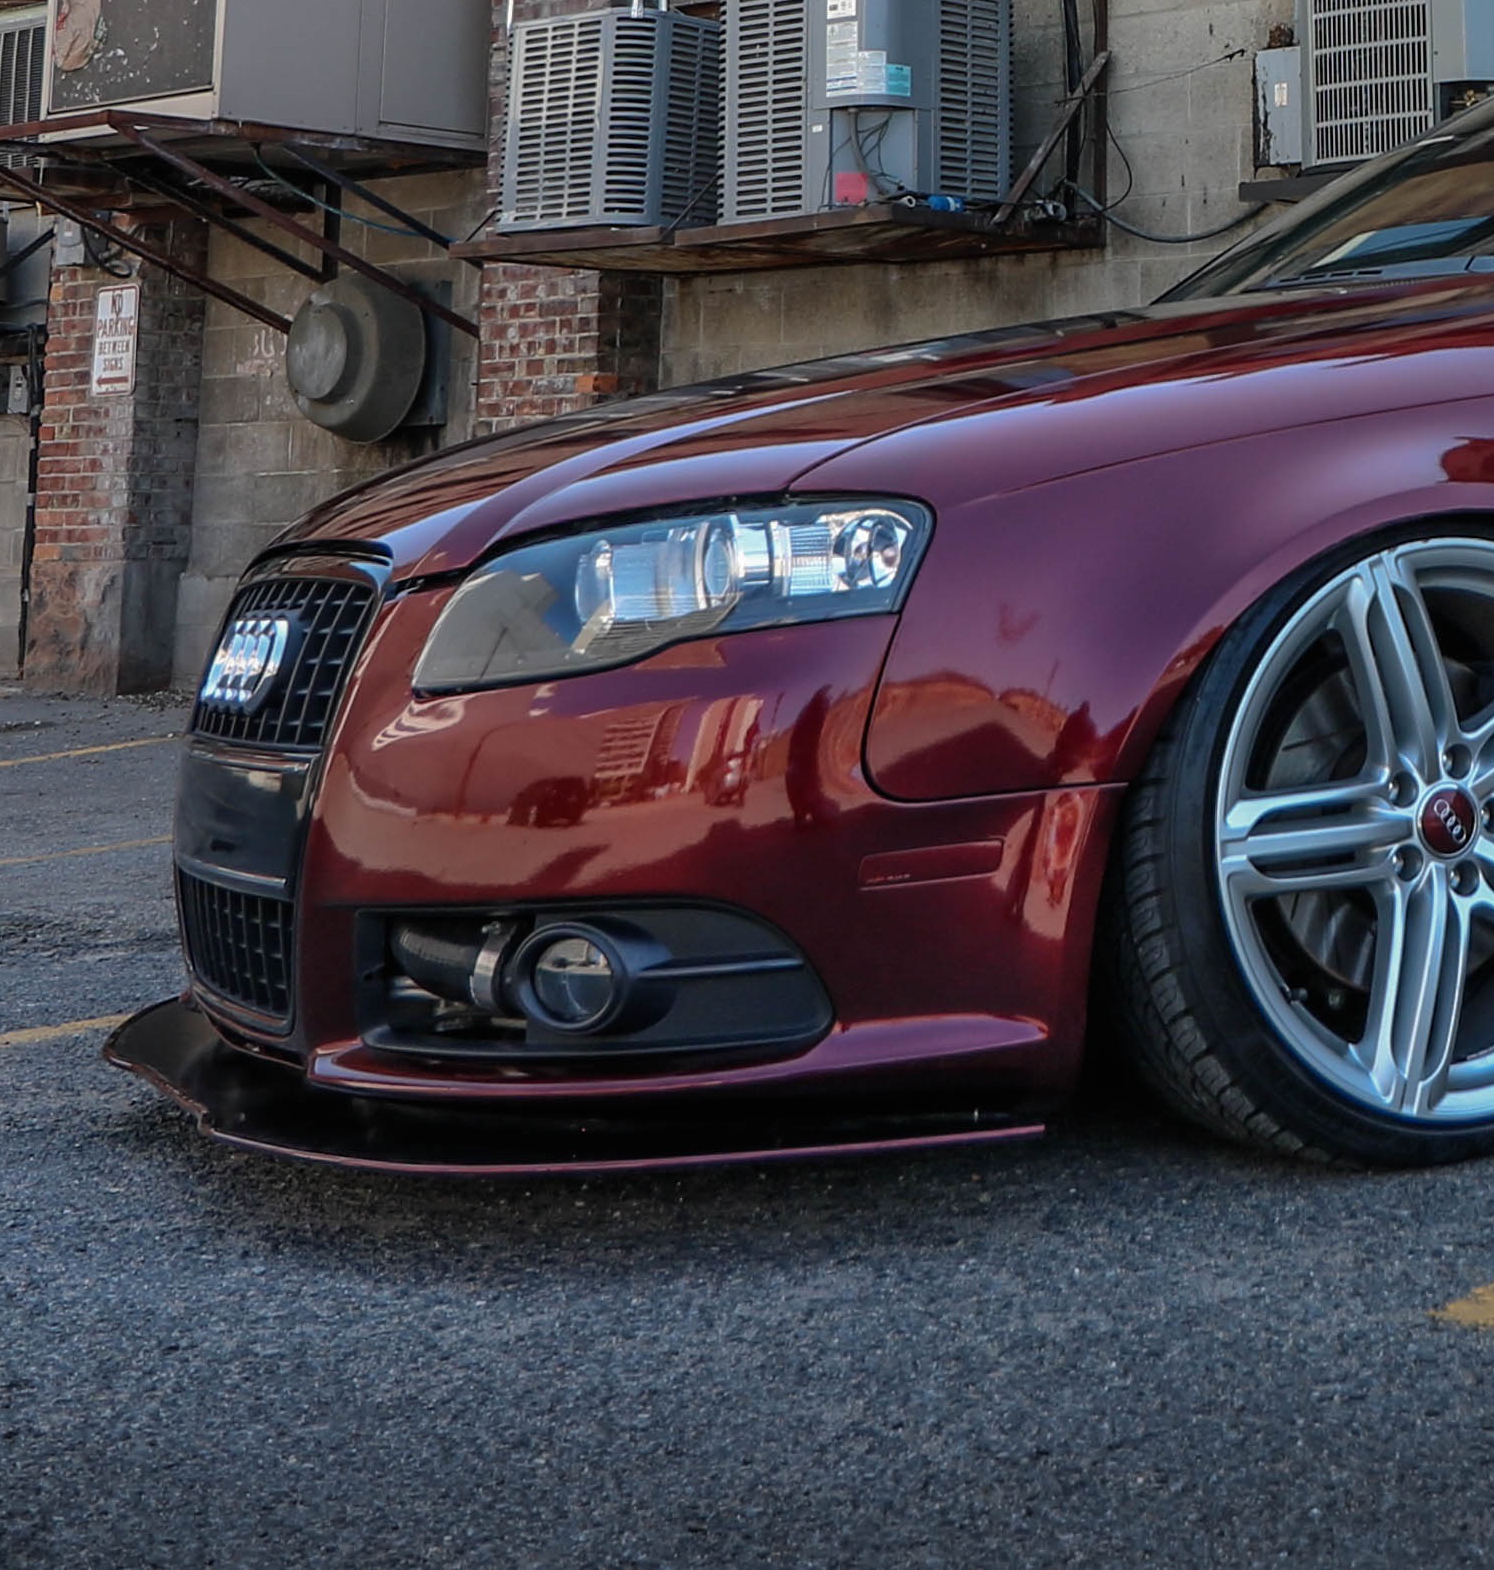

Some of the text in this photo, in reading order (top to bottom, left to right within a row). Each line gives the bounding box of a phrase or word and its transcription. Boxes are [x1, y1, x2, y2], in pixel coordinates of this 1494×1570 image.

[111, 292, 124, 314] NO
[97, 316, 135, 338] PARKING
[98, 339, 130, 356] BETWEEN
[103, 357, 123, 371] SIGNS
